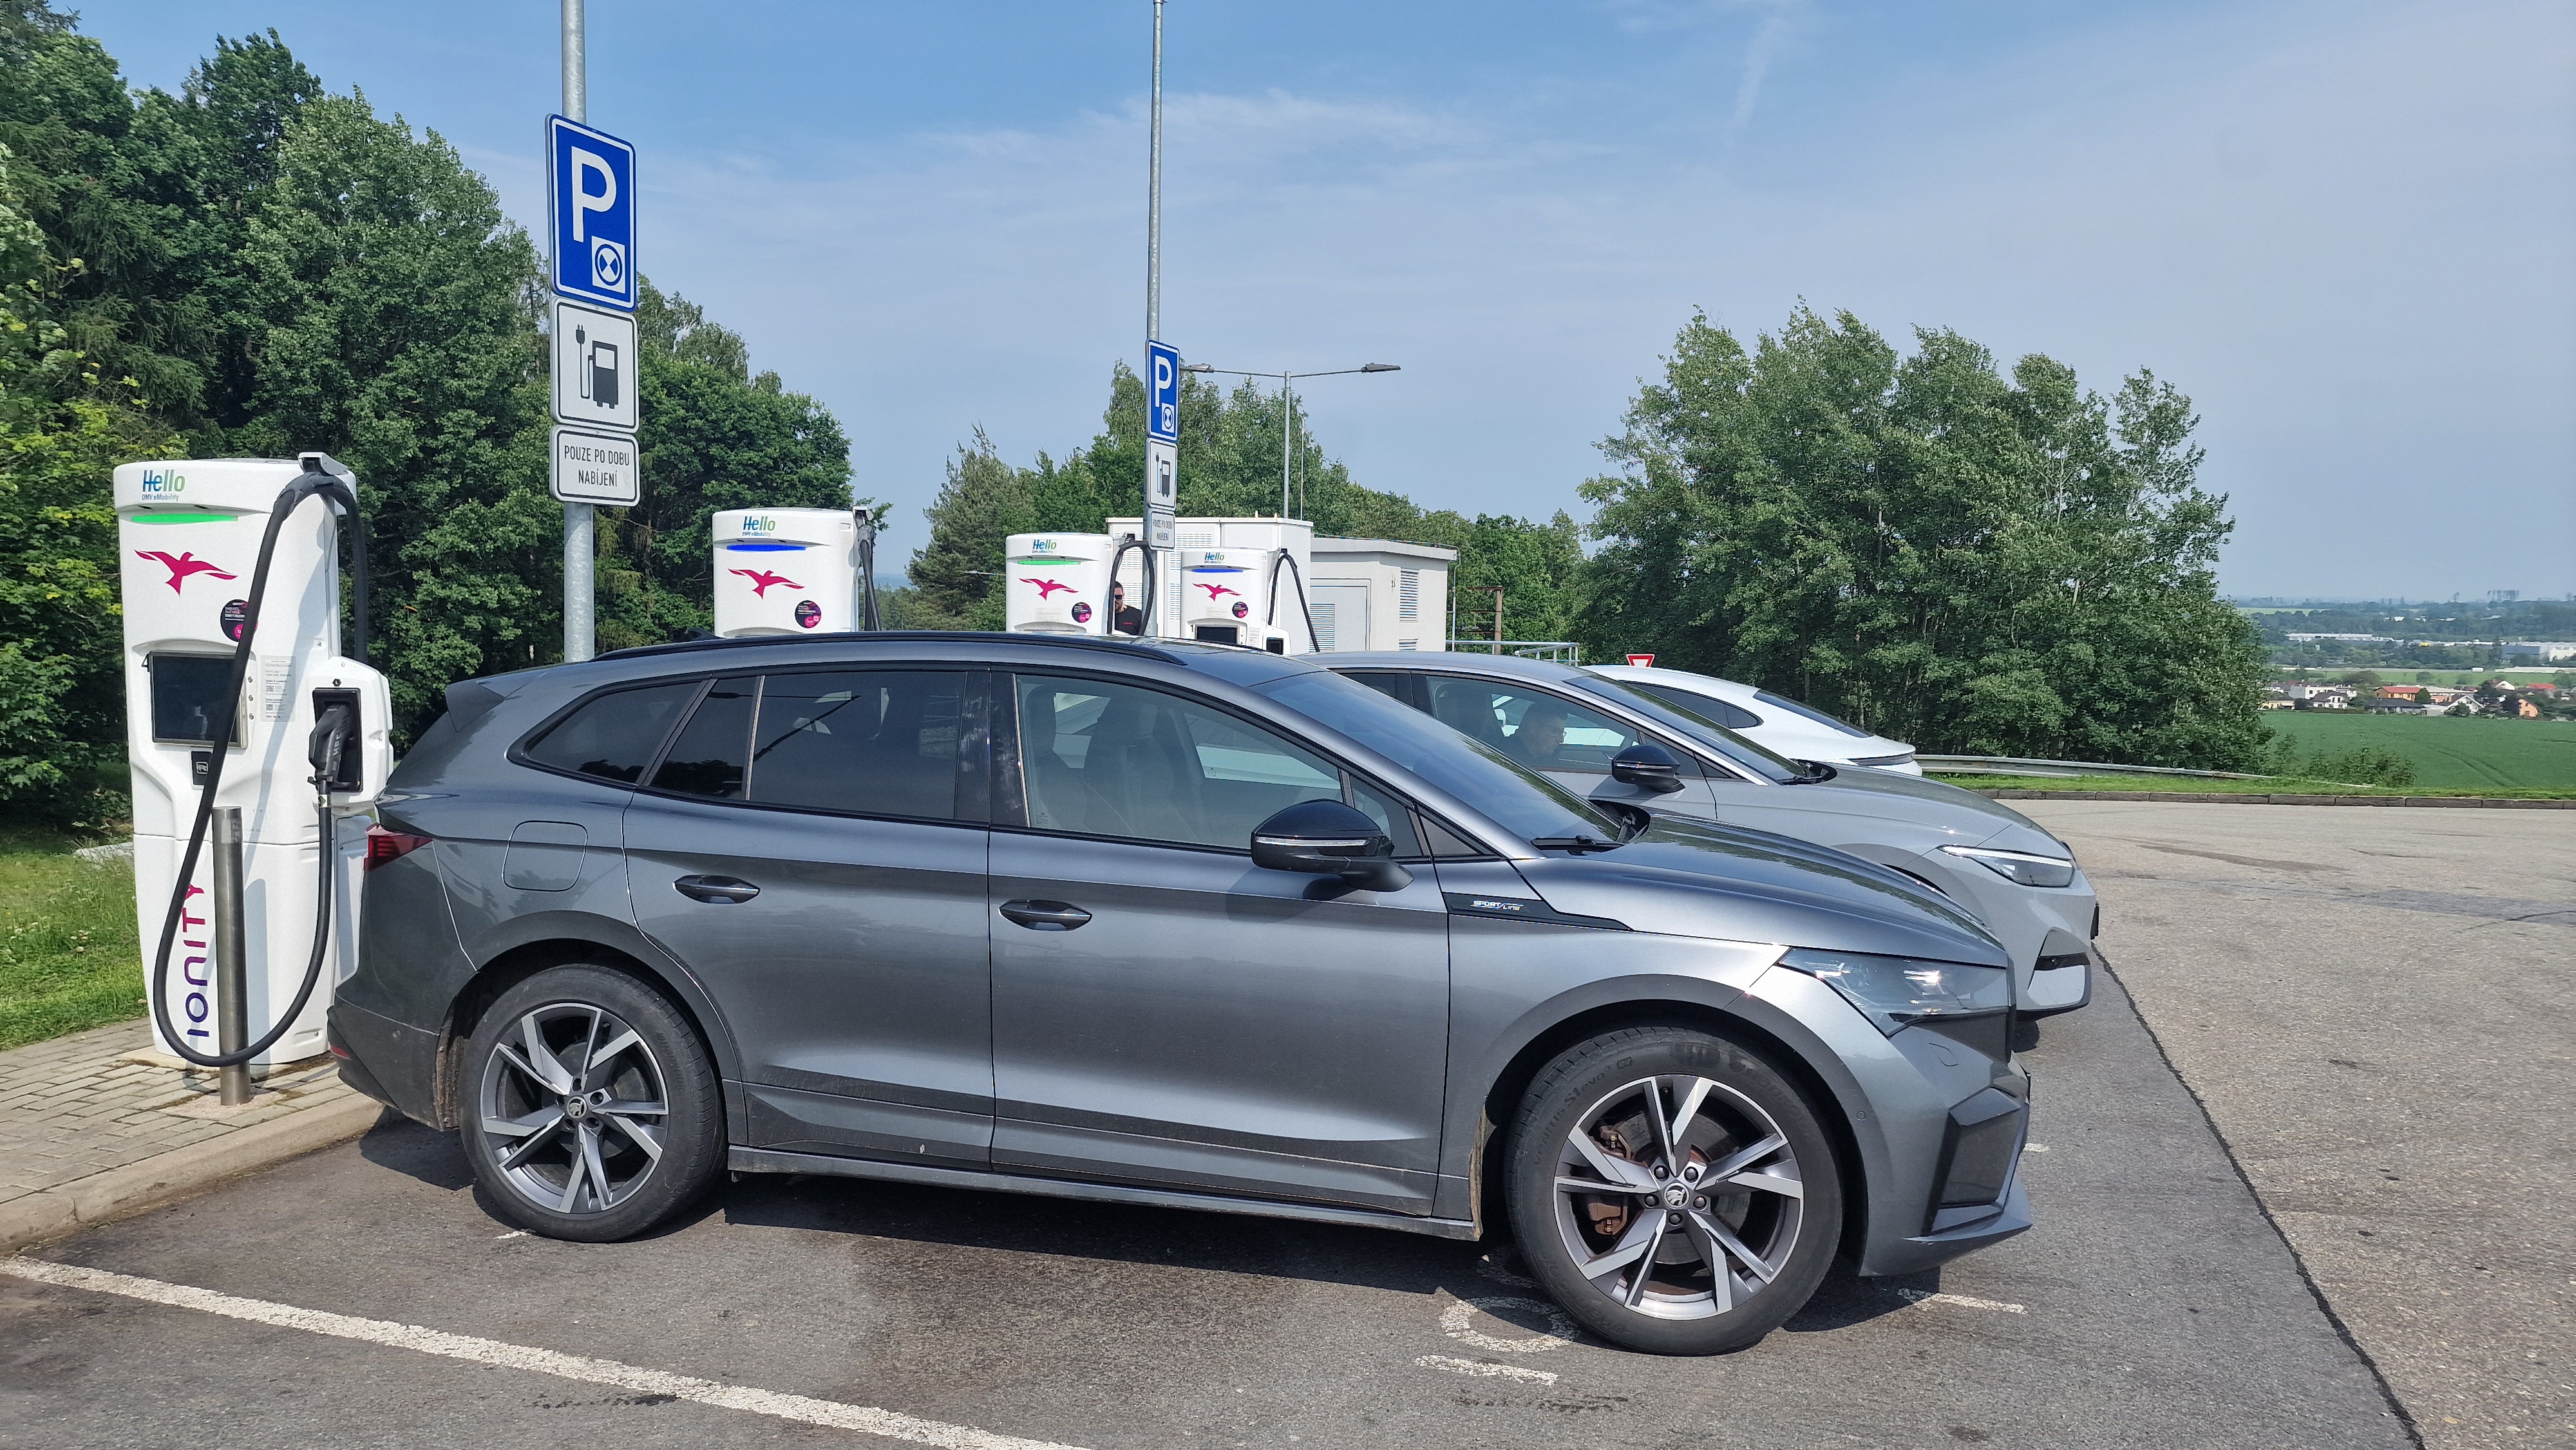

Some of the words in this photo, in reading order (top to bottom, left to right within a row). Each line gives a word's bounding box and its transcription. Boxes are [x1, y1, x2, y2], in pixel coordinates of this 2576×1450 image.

[572, 146, 616, 243] P
[1155, 355, 1172, 408] P
[565, 445, 591, 462] POUZE
[595, 449, 605, 463] PO
[609, 451, 629, 466] DOBU
[142, 469, 185, 492] Hello
[578, 468, 617, 487] NABÍJENÍ
[743, 516, 776, 531] Hello
[1032, 539, 1056, 549] Hello
[1204, 552, 1224, 561] Hello
[182, 883, 209, 1037] IONITY
